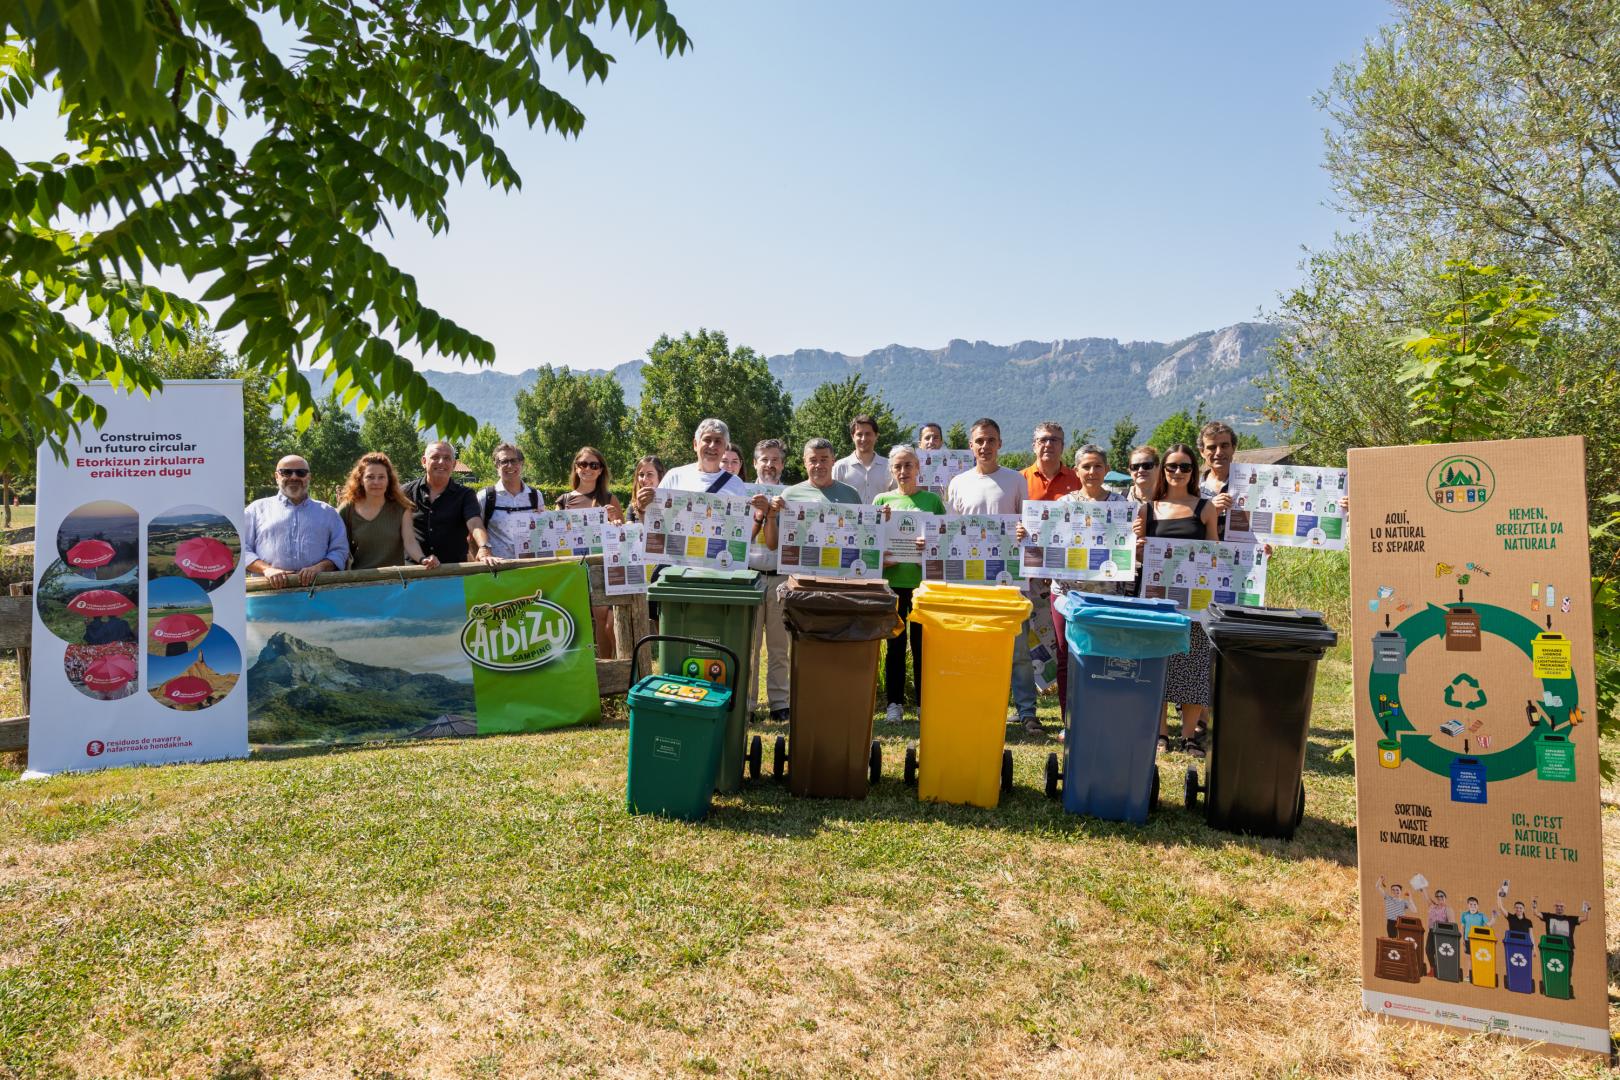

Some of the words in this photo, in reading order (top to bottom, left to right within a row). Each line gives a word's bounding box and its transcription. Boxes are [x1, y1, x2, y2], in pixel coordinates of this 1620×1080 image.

[100, 431, 182, 442] Construimos
[85, 444, 102, 454] un
[105, 443, 146, 453] futuro
[149, 442, 197, 453] circular
[76, 457, 140, 468] Etorkizun
[143, 456, 205, 467] zirkularra
[90, 468, 156, 479] eraikitzen
[159, 466, 191, 478] dugu
[1385, 510, 1410, 525] AQUÍ,
[1509, 507, 1548, 520] HEMEN,
[1370, 527, 1382, 539] LO
[1385, 526, 1426, 539] NATURAL
[1496, 522, 1548, 536] BEREIZTEA
[1550, 522, 1564, 534] DA
[1372, 541, 1383, 553] ES
[1386, 540, 1425, 553] SEPARAR
[1504, 537, 1556, 550] NATURALA
[511, 643, 552, 662] CAMPING
[106, 739, 140, 747] residuos
[141, 737, 150, 745] de
[152, 735, 182, 743] navarra
[106, 744, 149, 752] nafarroako
[150, 740, 193, 750] hondakinak
[1395, 803, 1433, 818] SORTING
[1399, 818, 1428, 832] WASTE
[1511, 813, 1529, 828] ICI,
[1533, 815, 1563, 829] C'EST
[1379, 830, 1389, 843] IS
[1390, 832, 1428, 847] NATURAL
[1430, 835, 1449, 849] HERE
[1515, 828, 1561, 845] NATUREL
[1499, 842, 1511, 855] DE
[1515, 844, 1541, 858] FAIRE
[1545, 847, 1557, 860] LE
[1561, 847, 1579, 863] TRI
